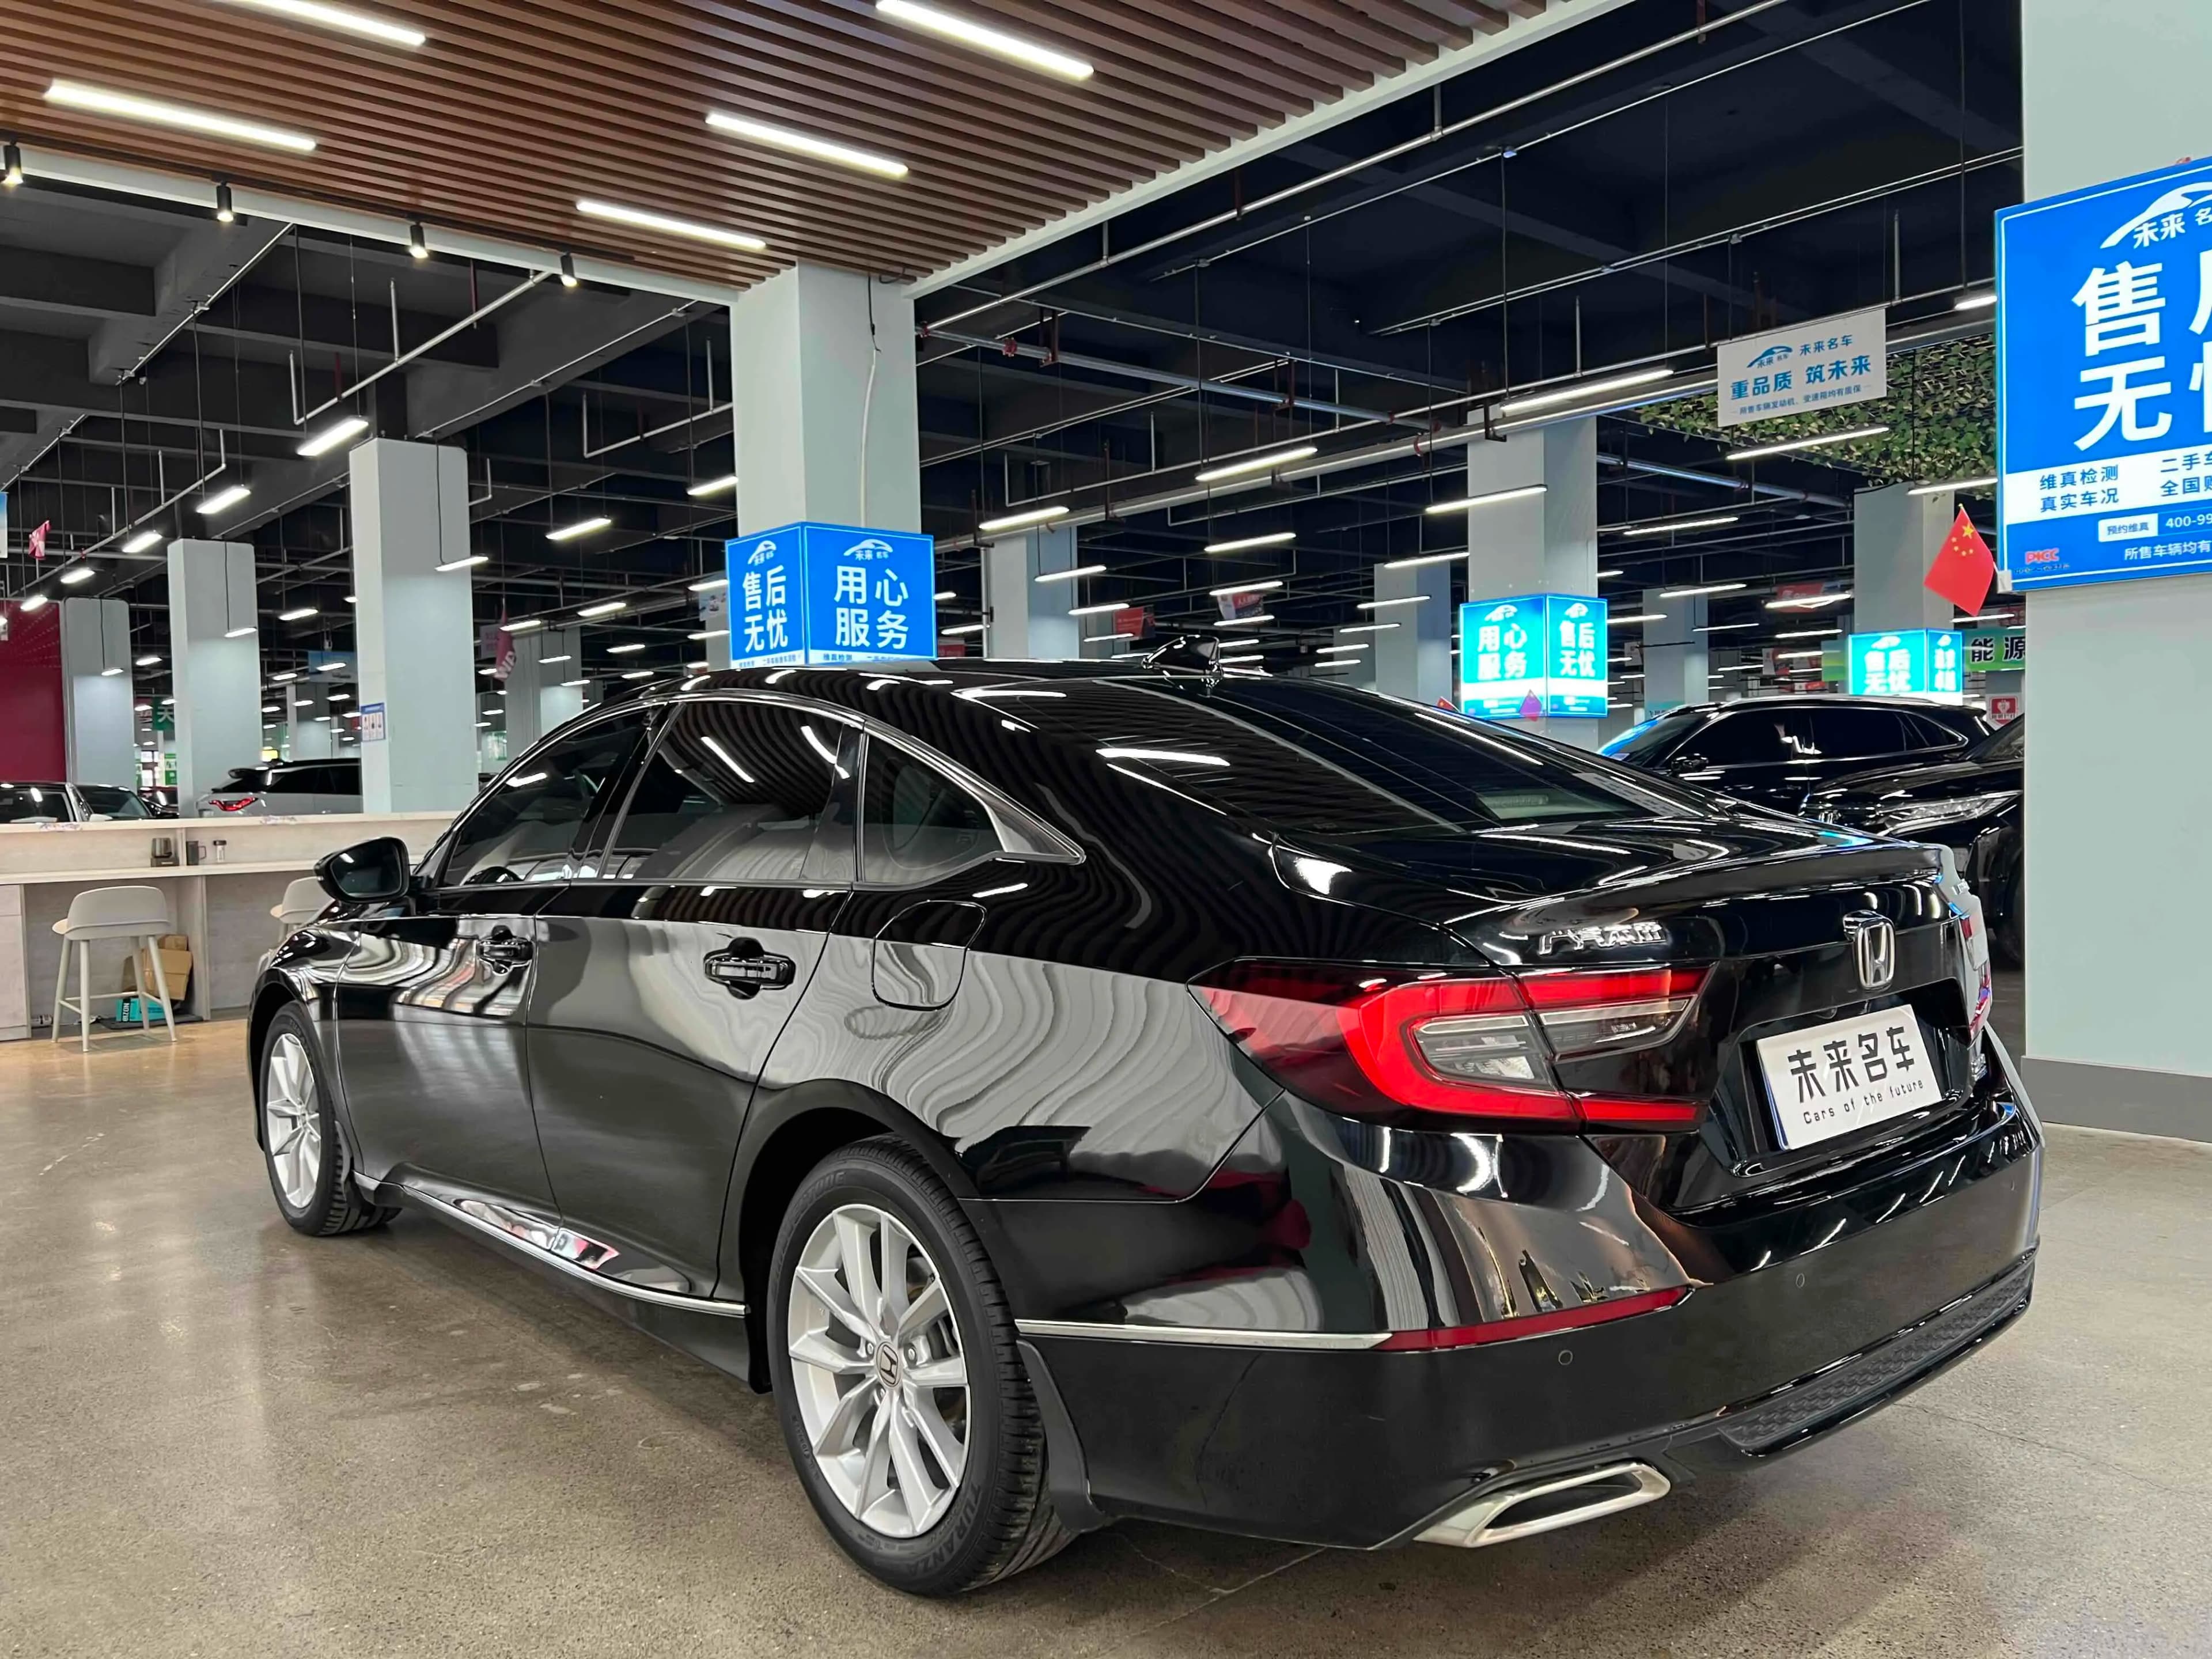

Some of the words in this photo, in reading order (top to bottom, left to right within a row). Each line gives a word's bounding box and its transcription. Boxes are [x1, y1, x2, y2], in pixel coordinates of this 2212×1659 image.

[2133, 213, 2186, 249] 未来
[1800, 335, 1853, 356] 未来名车
[1730, 370, 1793, 400] 重品质
[1805, 355, 1871, 384] 筑未来
[2040, 464, 2119, 490] 维真检测
[2040, 487, 2119, 513] 真实车况
[2107, 522, 2149, 535] 预约维真
[2124, 540, 2212, 560] 所售车辆均有
[742, 565, 786, 612] 售后
[834, 565, 909, 607] 用心
[744, 608, 789, 653] 无忧
[835, 607, 910, 650] 服务
[1478, 623, 1527, 652] 用心
[1787, 1026, 1915, 1104] 未来名车
[1803, 1107, 1835, 1124] Cars
[1843, 1098, 1856, 1112] of
[1863, 1090, 1883, 1106] the
[1889, 1079, 1924, 1098] future
